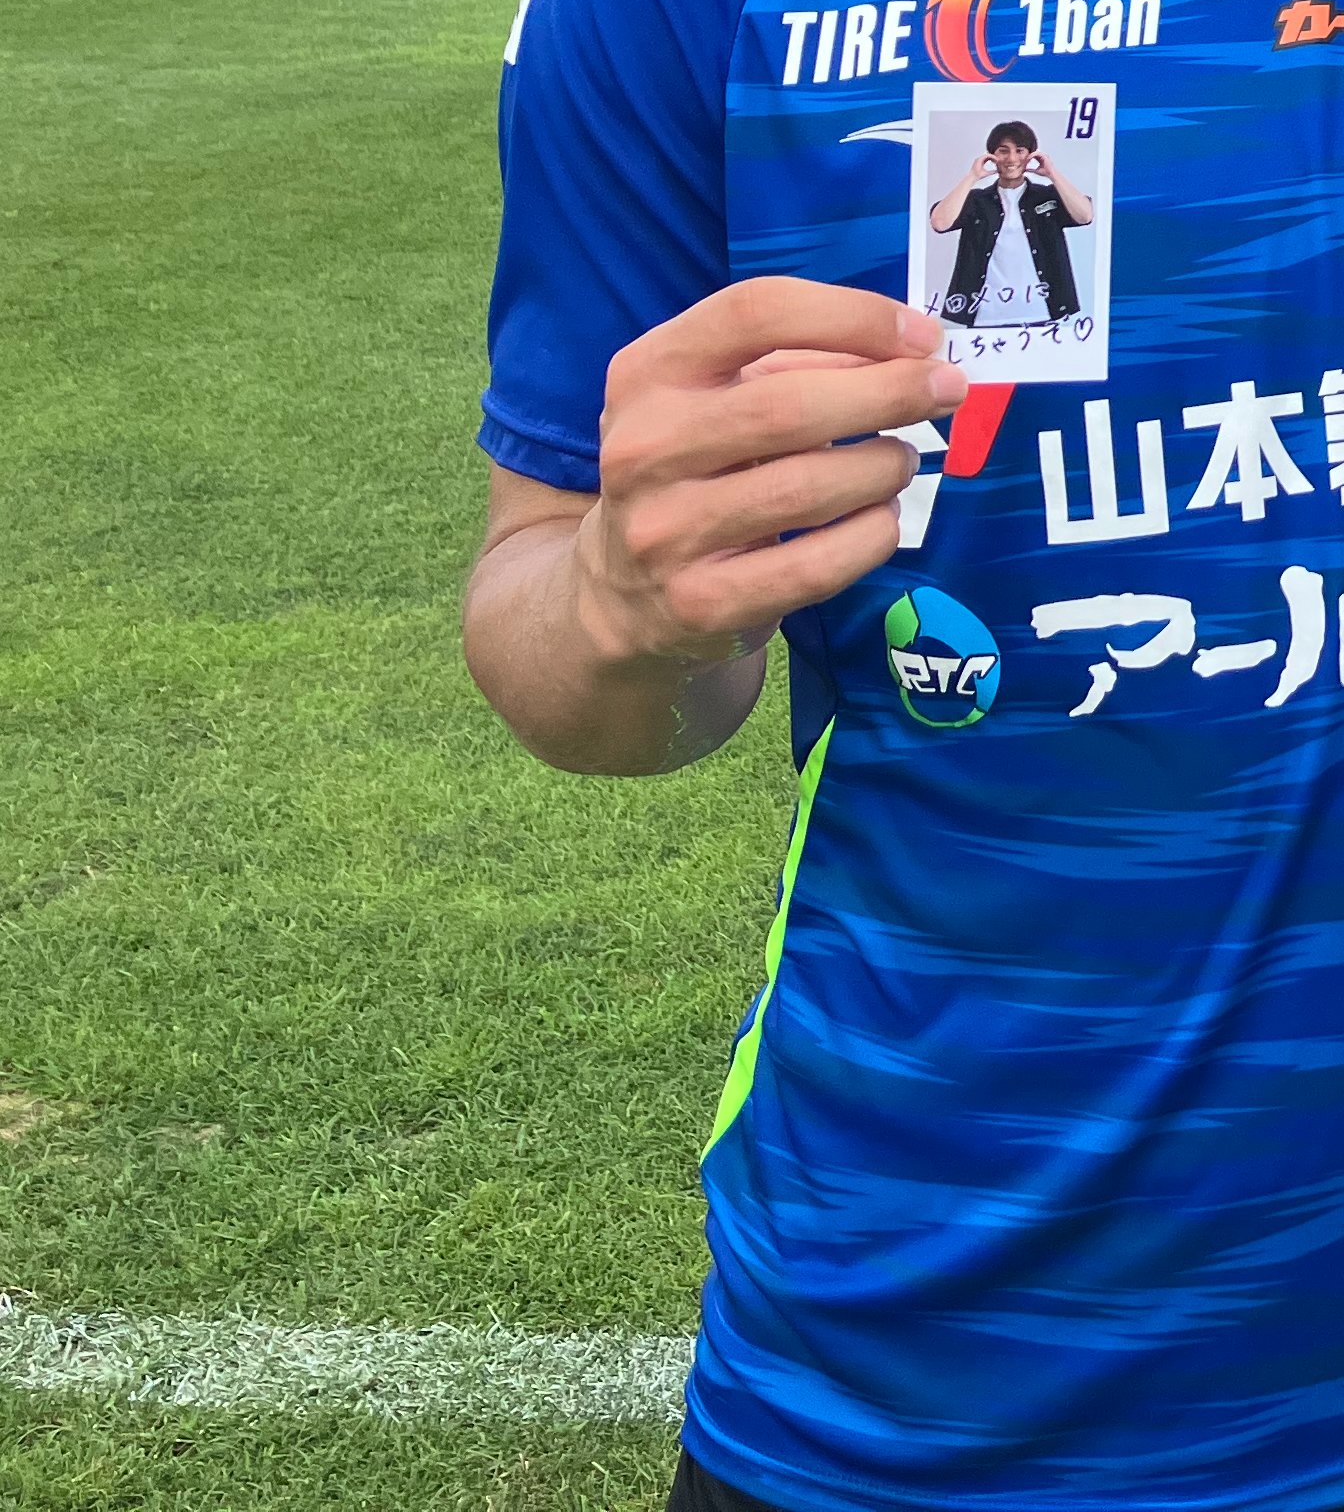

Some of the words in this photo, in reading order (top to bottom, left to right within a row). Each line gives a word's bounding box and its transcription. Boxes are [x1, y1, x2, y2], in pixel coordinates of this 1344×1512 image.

[781, 0, 917, 86] TIRE
[1065, 96, 1099, 139] 19
[890, 647, 996, 696] RTC
